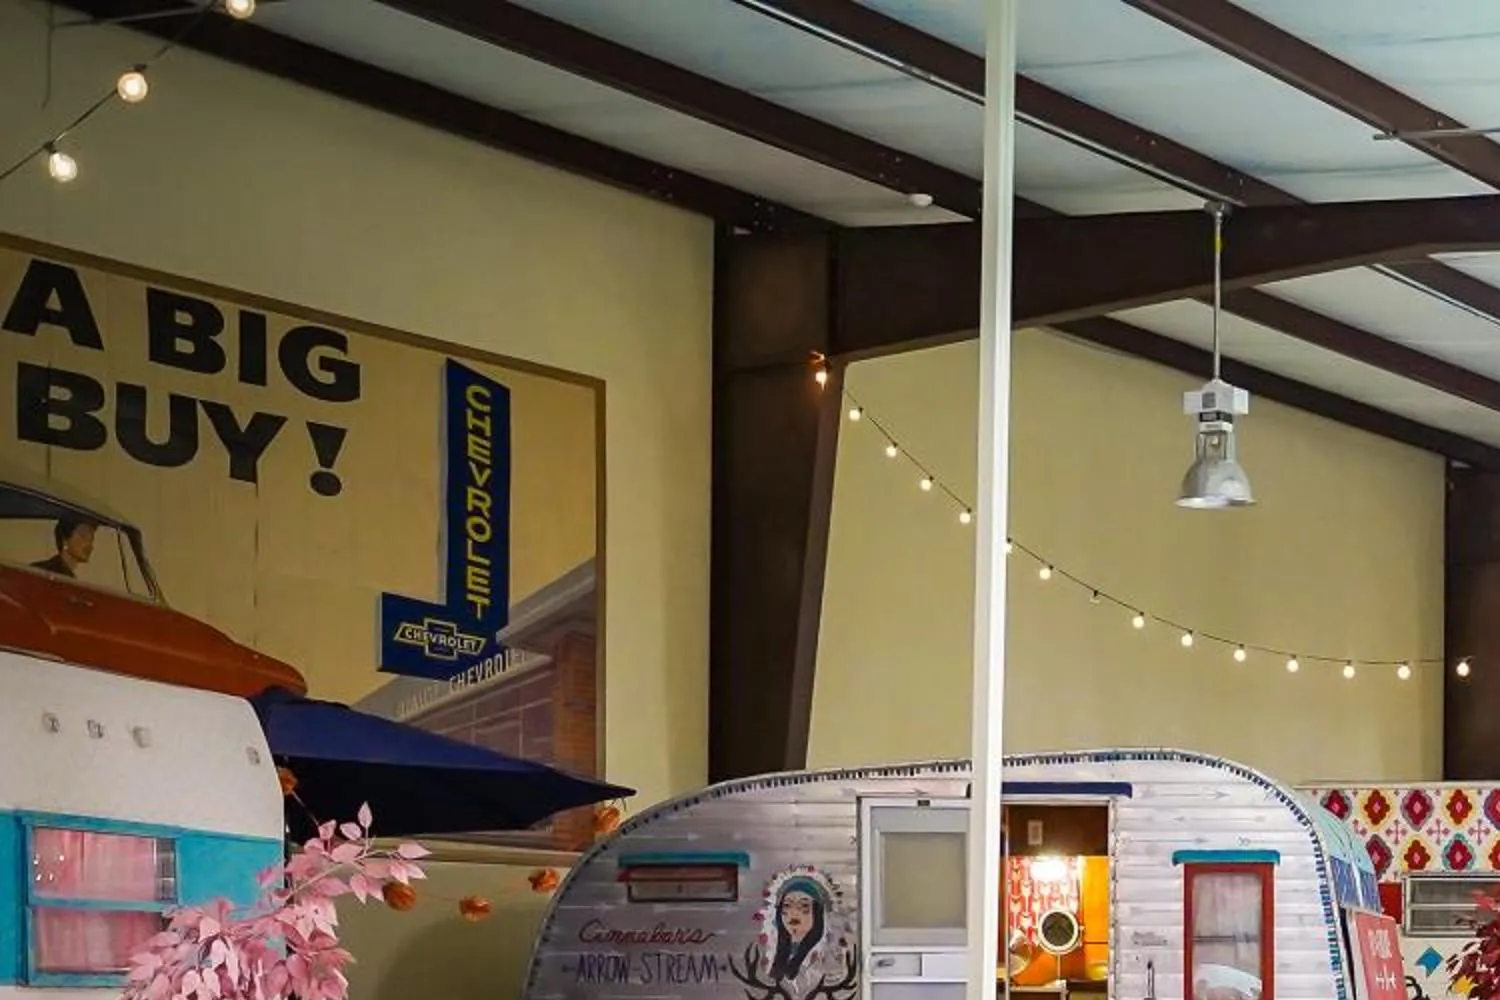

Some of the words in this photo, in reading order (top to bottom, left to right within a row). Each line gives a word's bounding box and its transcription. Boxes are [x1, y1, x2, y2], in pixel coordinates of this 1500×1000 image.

[2, 258, 104, 352] A
[145, 286, 361, 403] BIG
[465, 384, 493, 621] CHEVROLET
[404, 626, 478, 650] CHEVROLET
